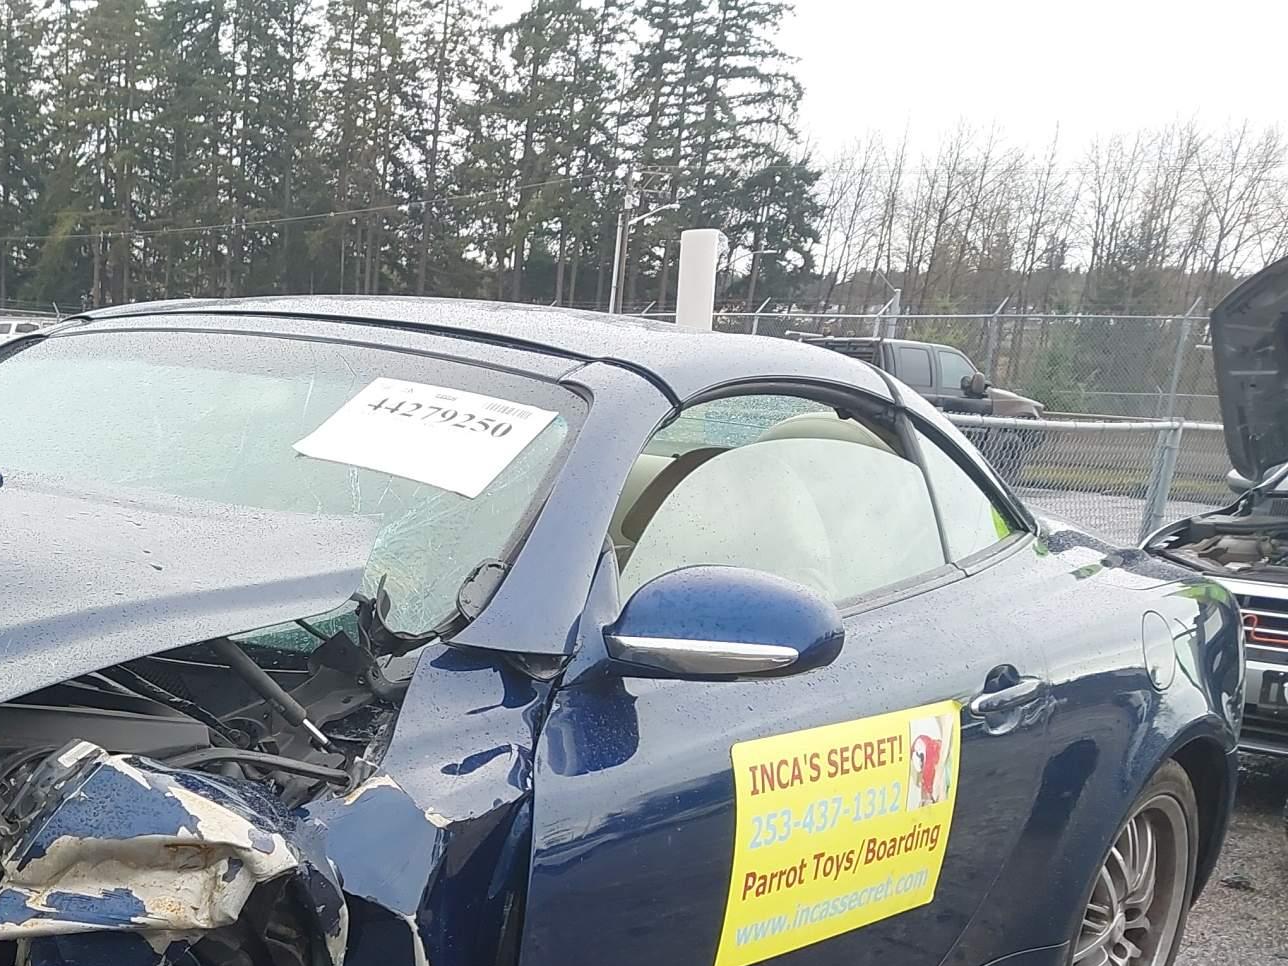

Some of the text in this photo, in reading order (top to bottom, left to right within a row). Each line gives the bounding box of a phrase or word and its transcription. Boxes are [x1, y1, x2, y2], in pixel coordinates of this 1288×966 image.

[367, 398, 513, 438] 44279250
[748, 735, 903, 796] INCA'S SECRET!
[748, 782, 902, 849] 253-437-1312
[741, 823, 942, 901] Parrot Toys/Boarding
[735, 868, 929, 946] www.incassecret.com
